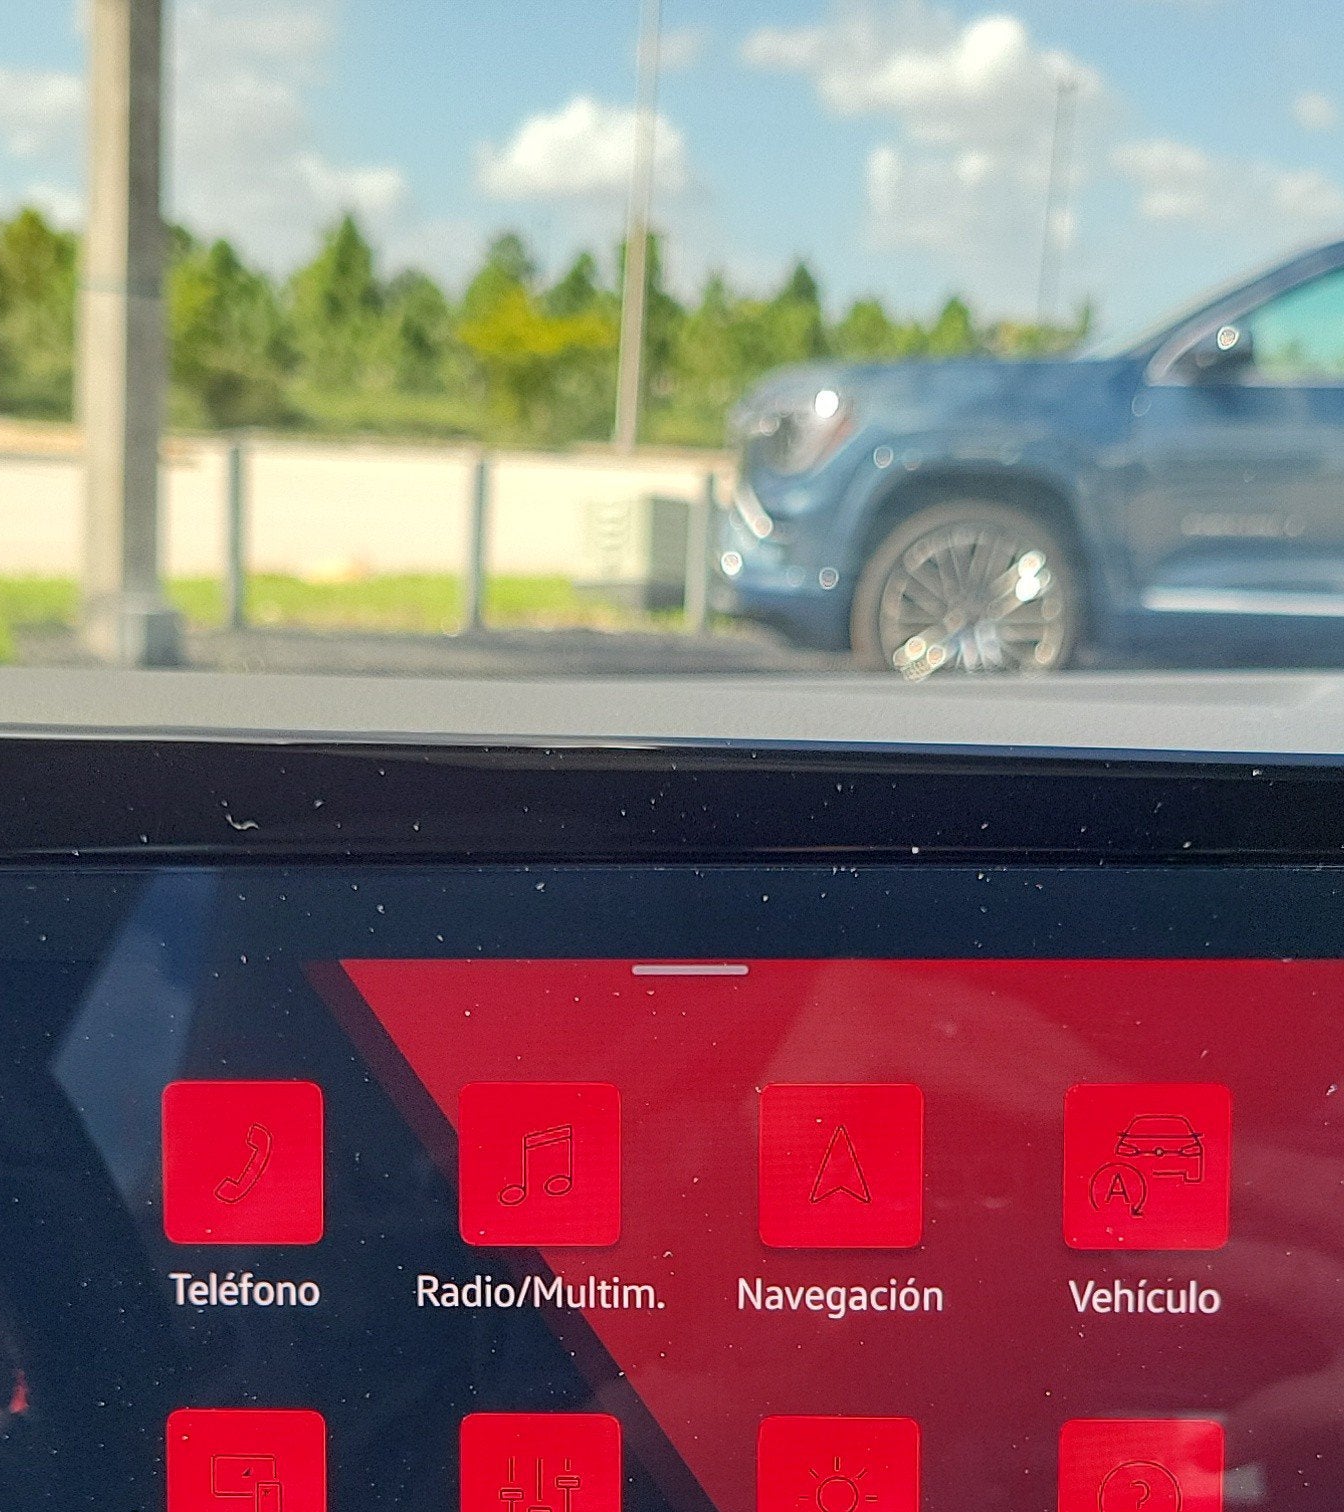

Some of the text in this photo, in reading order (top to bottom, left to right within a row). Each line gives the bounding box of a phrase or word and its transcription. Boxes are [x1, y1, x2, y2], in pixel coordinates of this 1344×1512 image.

[169, 1271, 320, 1308] Teléfono
[417, 1273, 666, 1311] Radio/Multim.
[738, 1276, 943, 1319] Navegación
[1068, 1278, 1221, 1316] Vehículo
